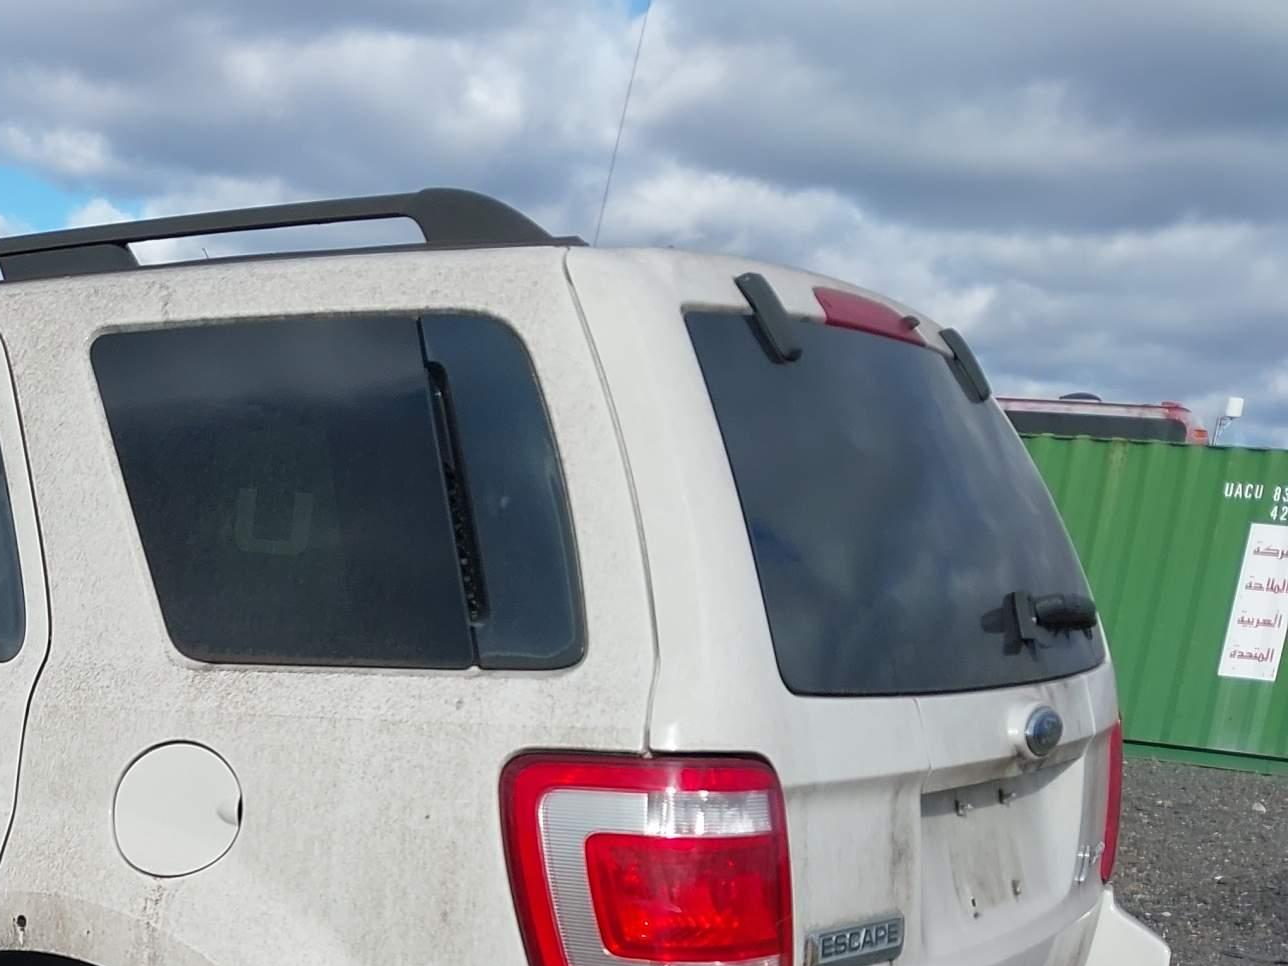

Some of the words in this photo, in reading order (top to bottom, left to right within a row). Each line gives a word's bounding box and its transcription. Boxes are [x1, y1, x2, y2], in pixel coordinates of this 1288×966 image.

[1224, 482, 1265, 499] UACU
[1237, 610, 1282, 629] العربية
[1229, 644, 1275, 663] المتحدة
[820, 923, 899, 959] ESCAPE
